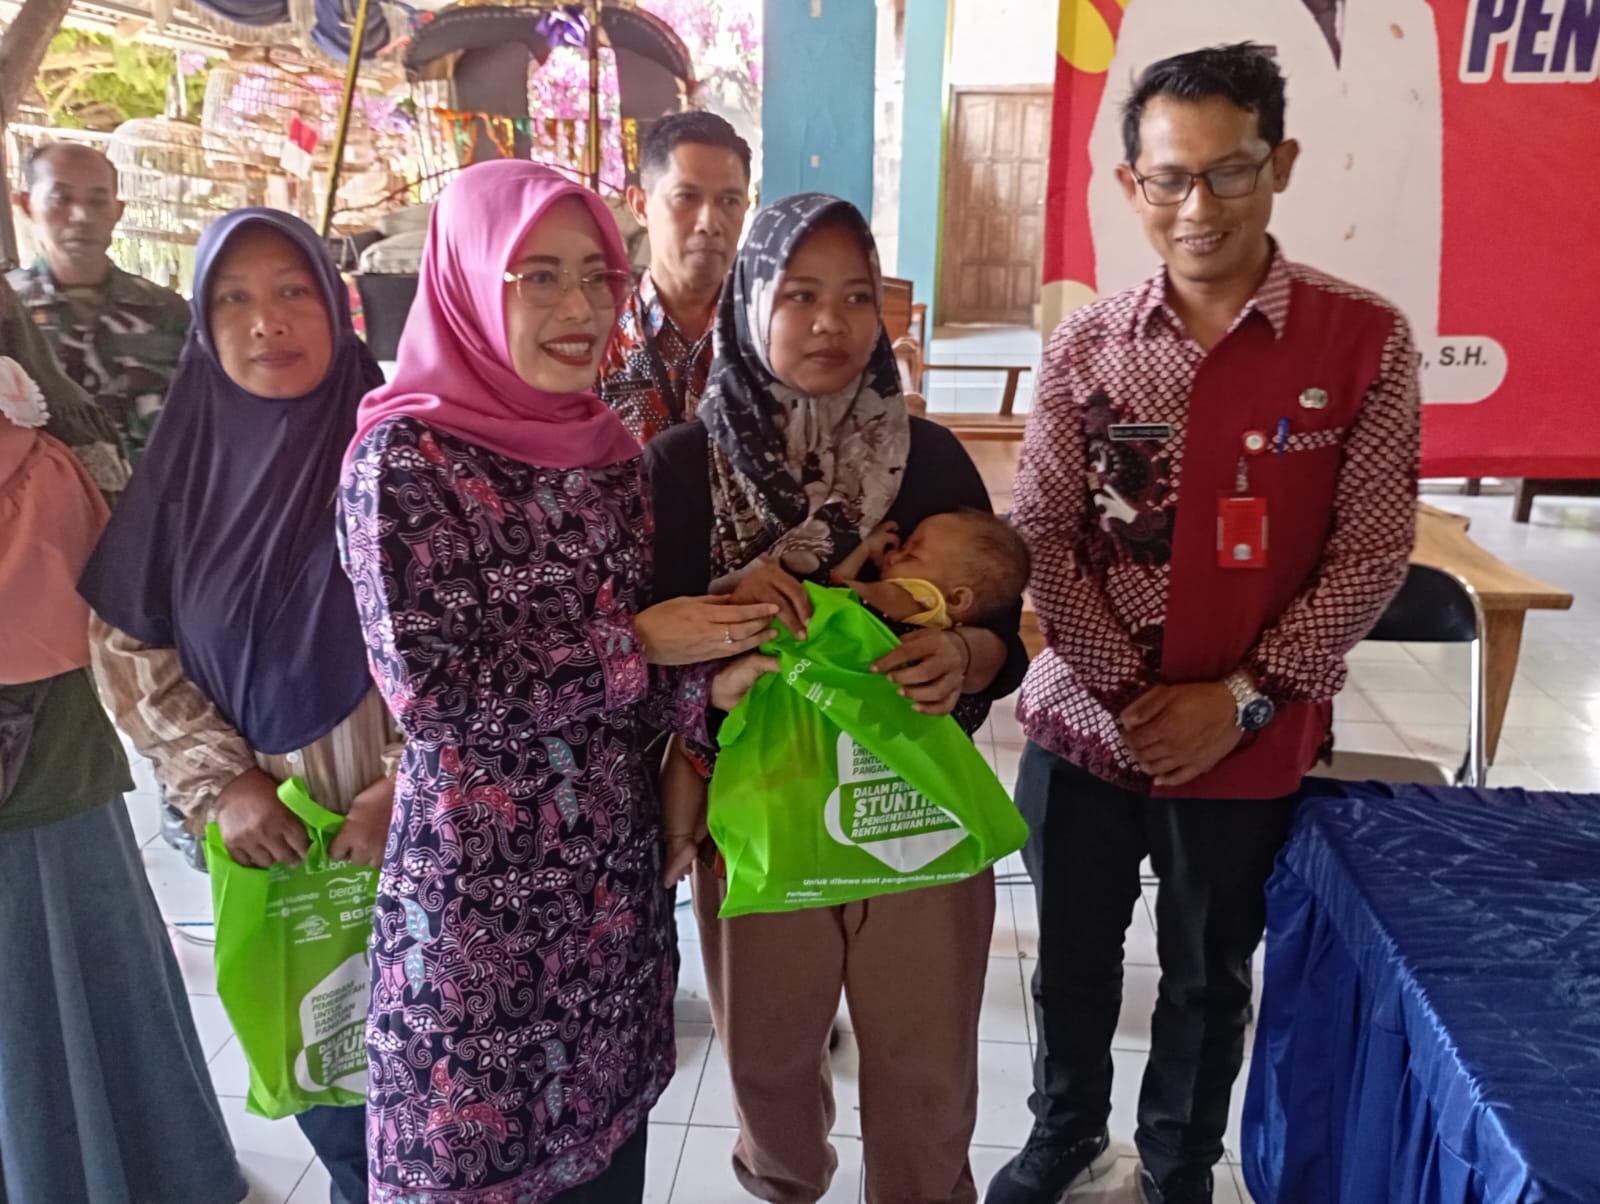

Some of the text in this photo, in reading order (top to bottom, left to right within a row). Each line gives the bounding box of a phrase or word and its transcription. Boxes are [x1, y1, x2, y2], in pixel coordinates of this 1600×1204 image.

[1439, 346, 1487, 367] S.H.
[853, 783, 889, 799] DALAM
[853, 791, 934, 818] STUNTI
[862, 809, 924, 827] PENGENTASAN
[850, 825, 888, 839] RENTAN
[889, 819, 923, 833] RAWAN
